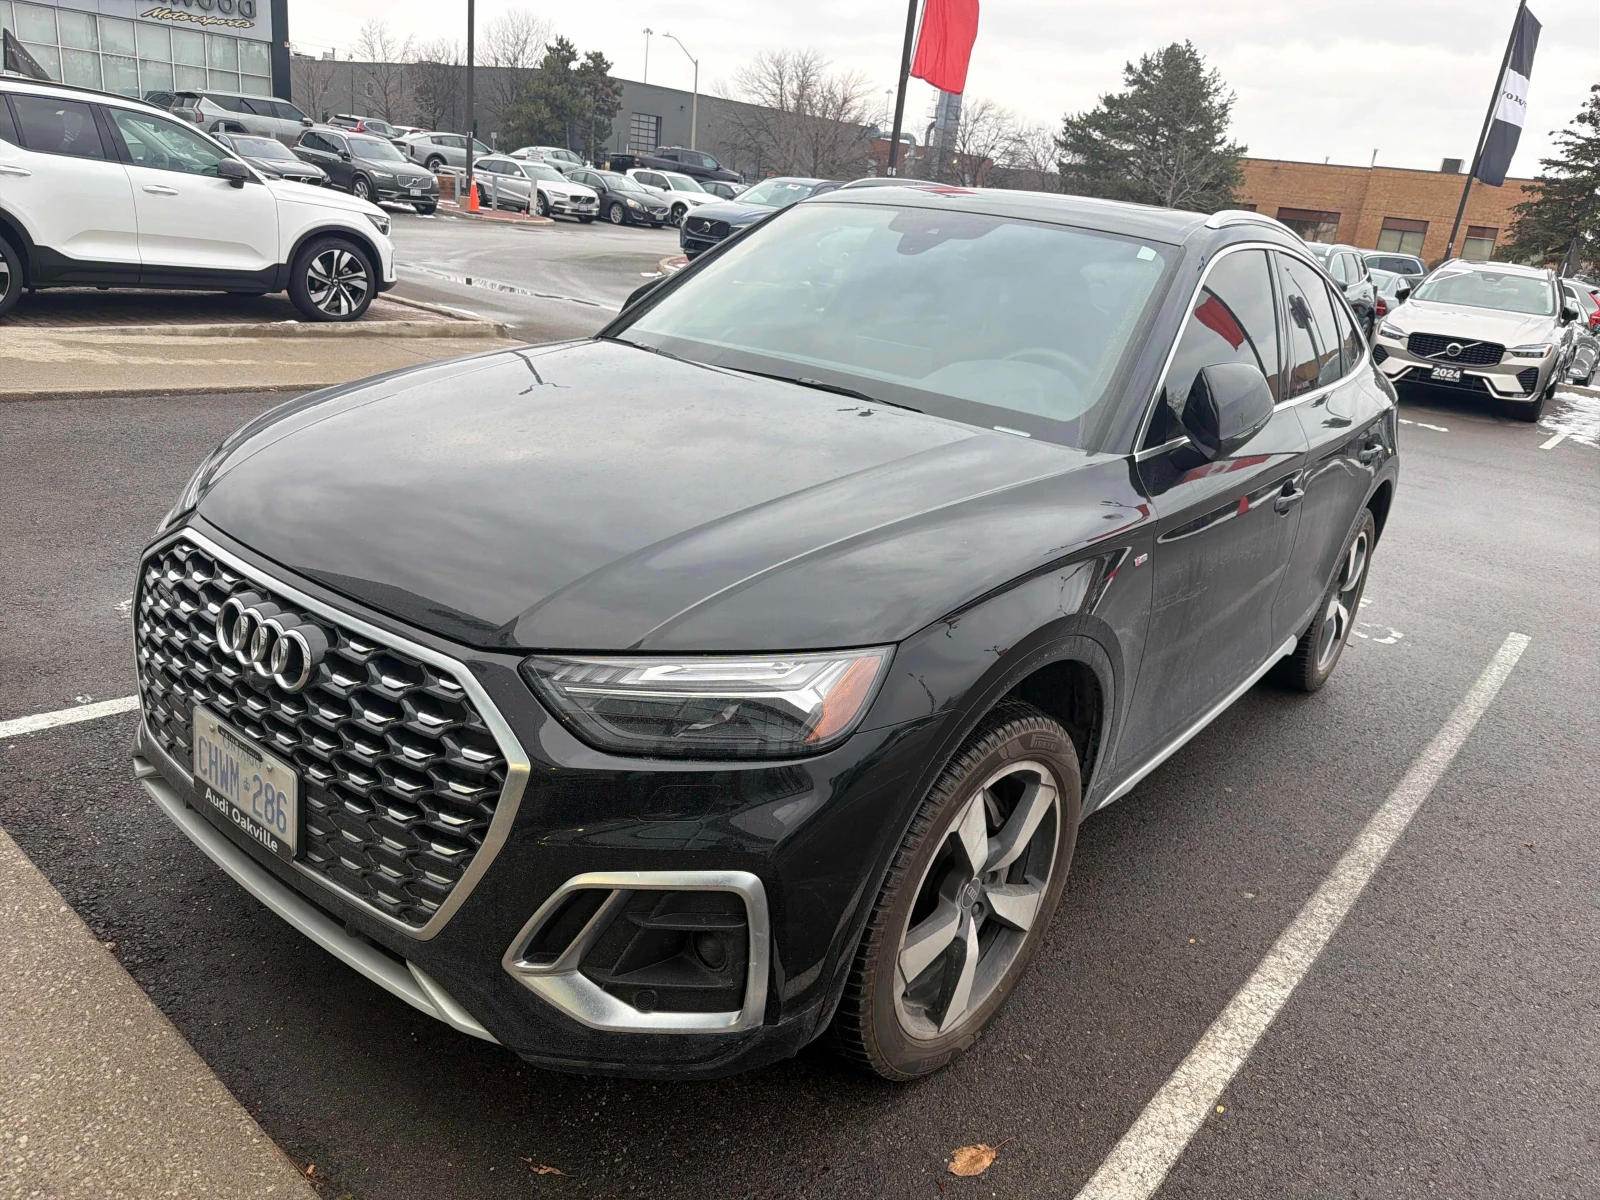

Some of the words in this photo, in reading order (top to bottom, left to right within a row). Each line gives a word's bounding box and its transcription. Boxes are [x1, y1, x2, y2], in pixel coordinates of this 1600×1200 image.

[140, 7, 255, 29] Motorsports
[1431, 367, 1461, 379] 2024
[198, 735, 240, 802] CHWM
[252, 774, 288, 835] 286
[205, 787, 229, 816] Audi
[232, 808, 278, 853] Oakville
